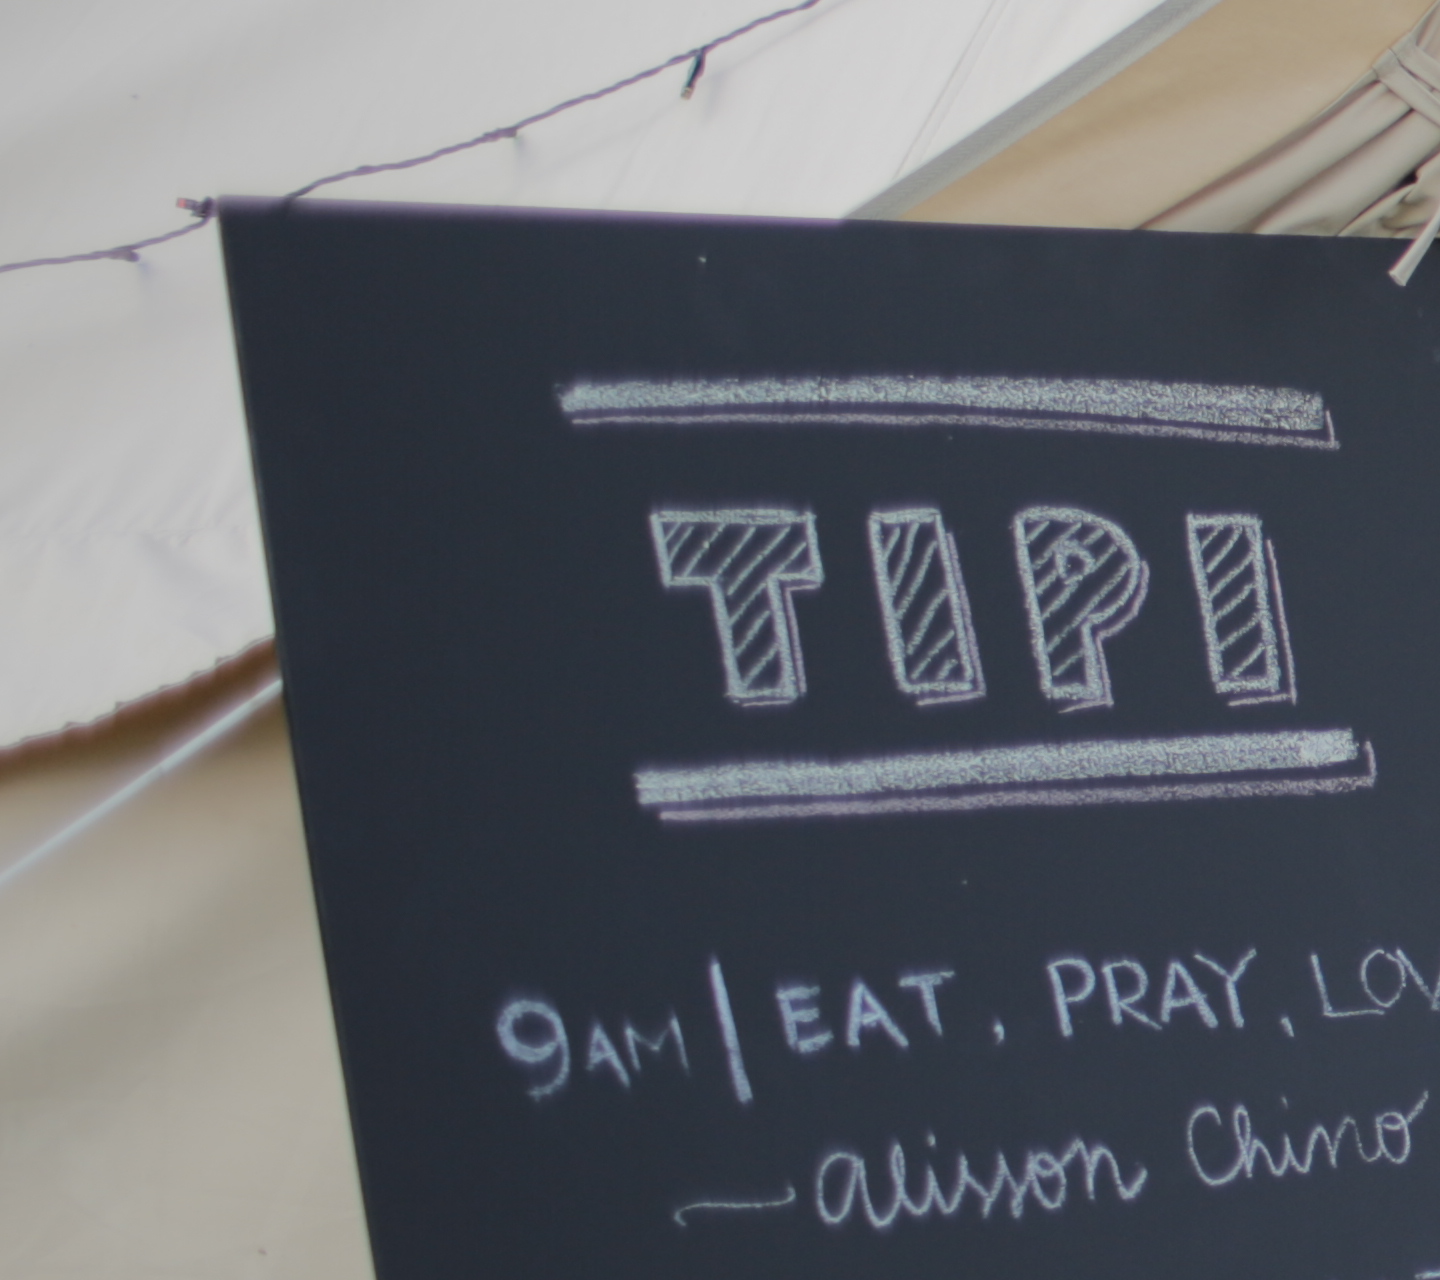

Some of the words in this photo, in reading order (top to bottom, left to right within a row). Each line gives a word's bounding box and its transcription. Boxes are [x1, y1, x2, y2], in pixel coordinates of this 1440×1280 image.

[650, 505, 1298, 713] TIPI
[498, 997, 690, 1102] 9AM
[1187, 1089, 1429, 1186] Chino
